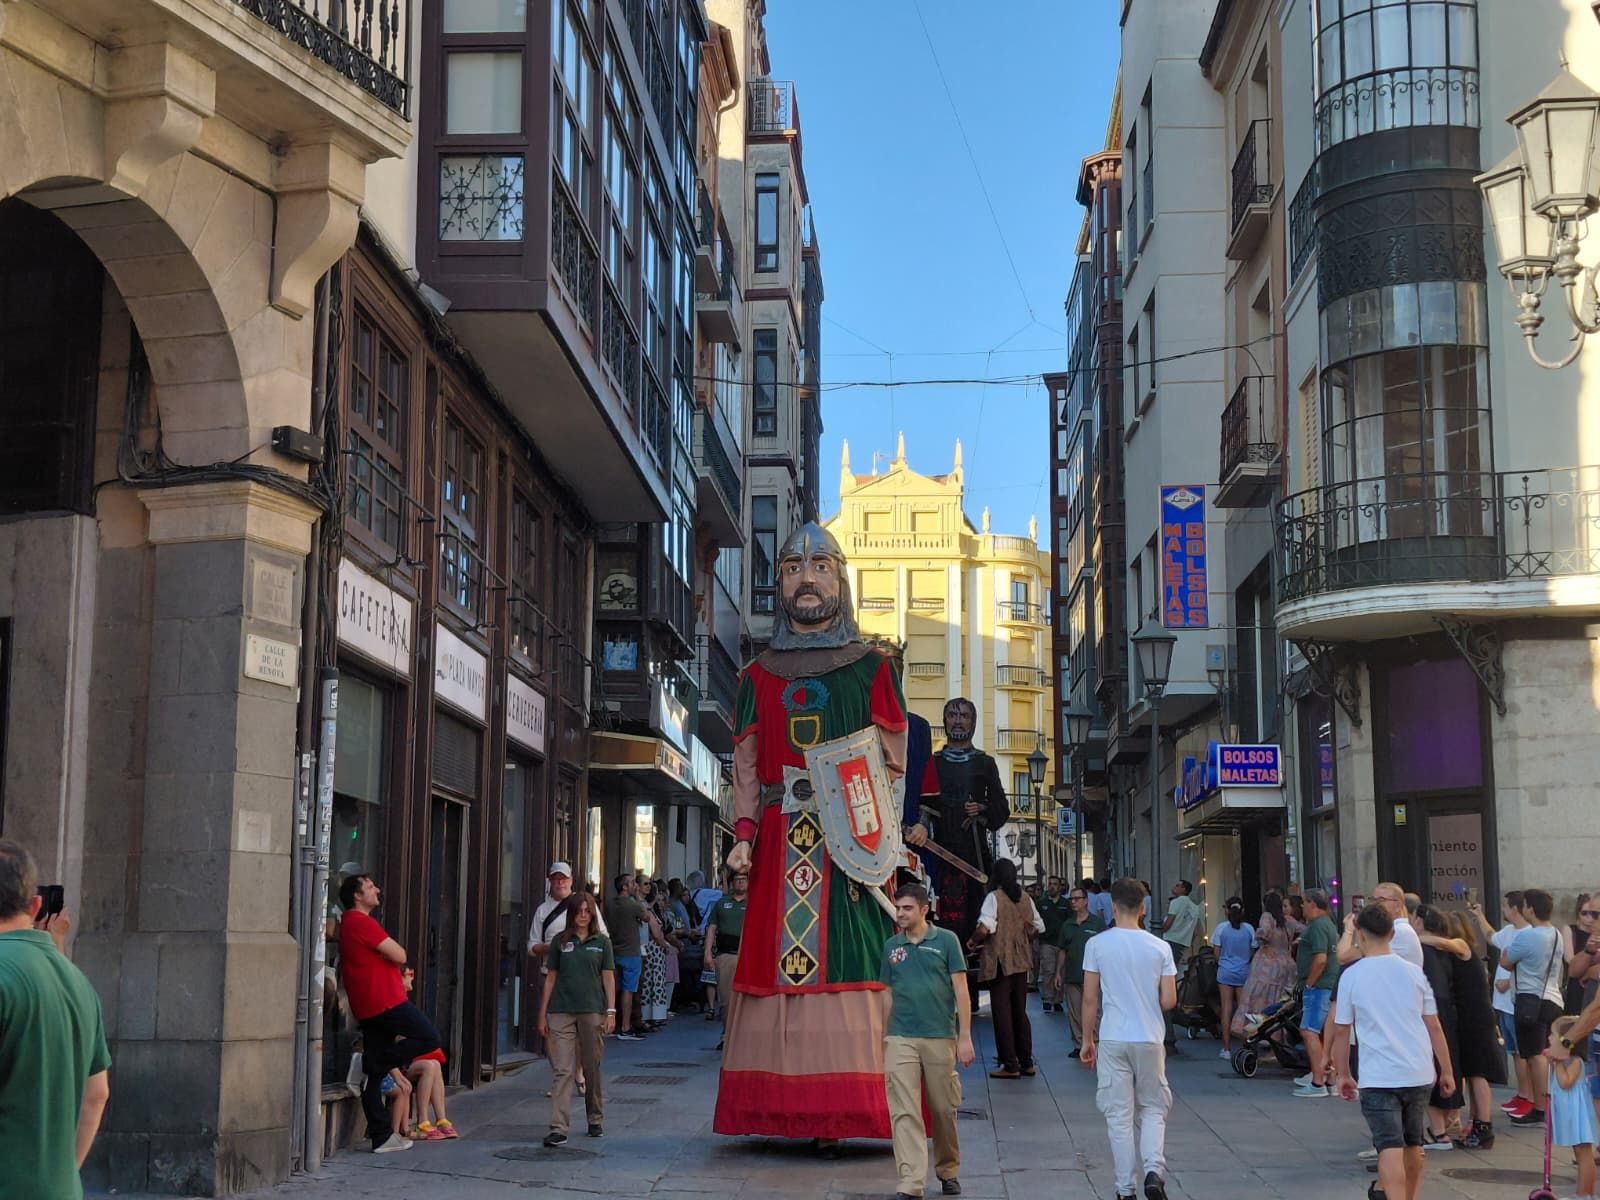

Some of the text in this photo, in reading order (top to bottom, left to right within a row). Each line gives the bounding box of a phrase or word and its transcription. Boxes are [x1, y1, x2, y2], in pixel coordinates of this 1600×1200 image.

[1165, 523, 1184, 625] MALETAS
[1186, 522, 1205, 626] BOLSOS
[342, 580, 407, 654] CAFETERÍA
[262, 655, 283, 668] DE LA
[265, 644, 287, 657] CALLE
[448, 653, 466, 687] PLAZA
[1223, 750, 1274, 764] BOLSOS
[1221, 768, 1278, 782] MALETAS
